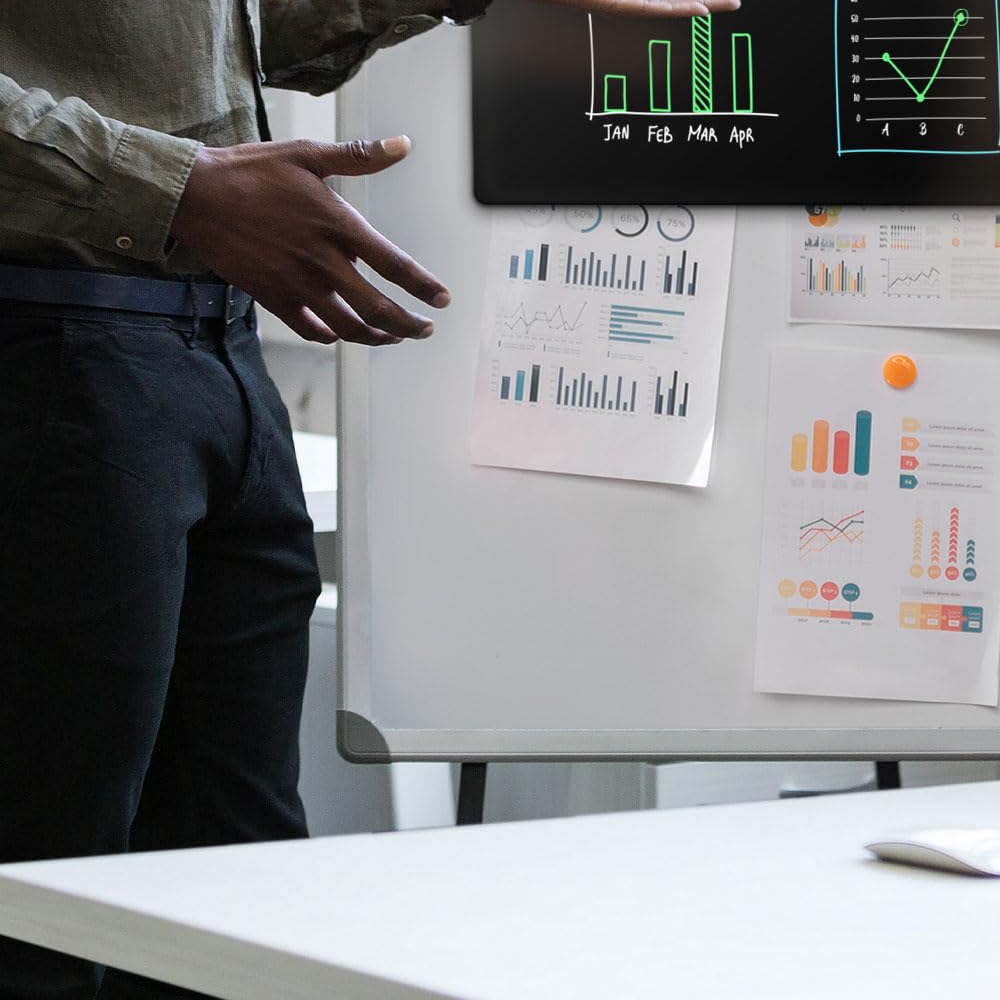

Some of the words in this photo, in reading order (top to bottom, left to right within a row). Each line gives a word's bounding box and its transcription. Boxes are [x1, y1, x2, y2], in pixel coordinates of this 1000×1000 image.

[850, 14, 859, 23] 50
[851, 34, 860, 43] 40
[851, 54, 860, 63] 30
[851, 73, 860, 84] 20
[853, 93, 861, 102] 10
[855, 113, 861, 122] 0
[603, 123, 630, 142] JAN
[647, 124, 673, 144] FEB
[687, 124, 718, 143] MAR
[881, 122, 890, 137] A
[919, 121, 928, 136] B
[956, 123, 965, 136] C
